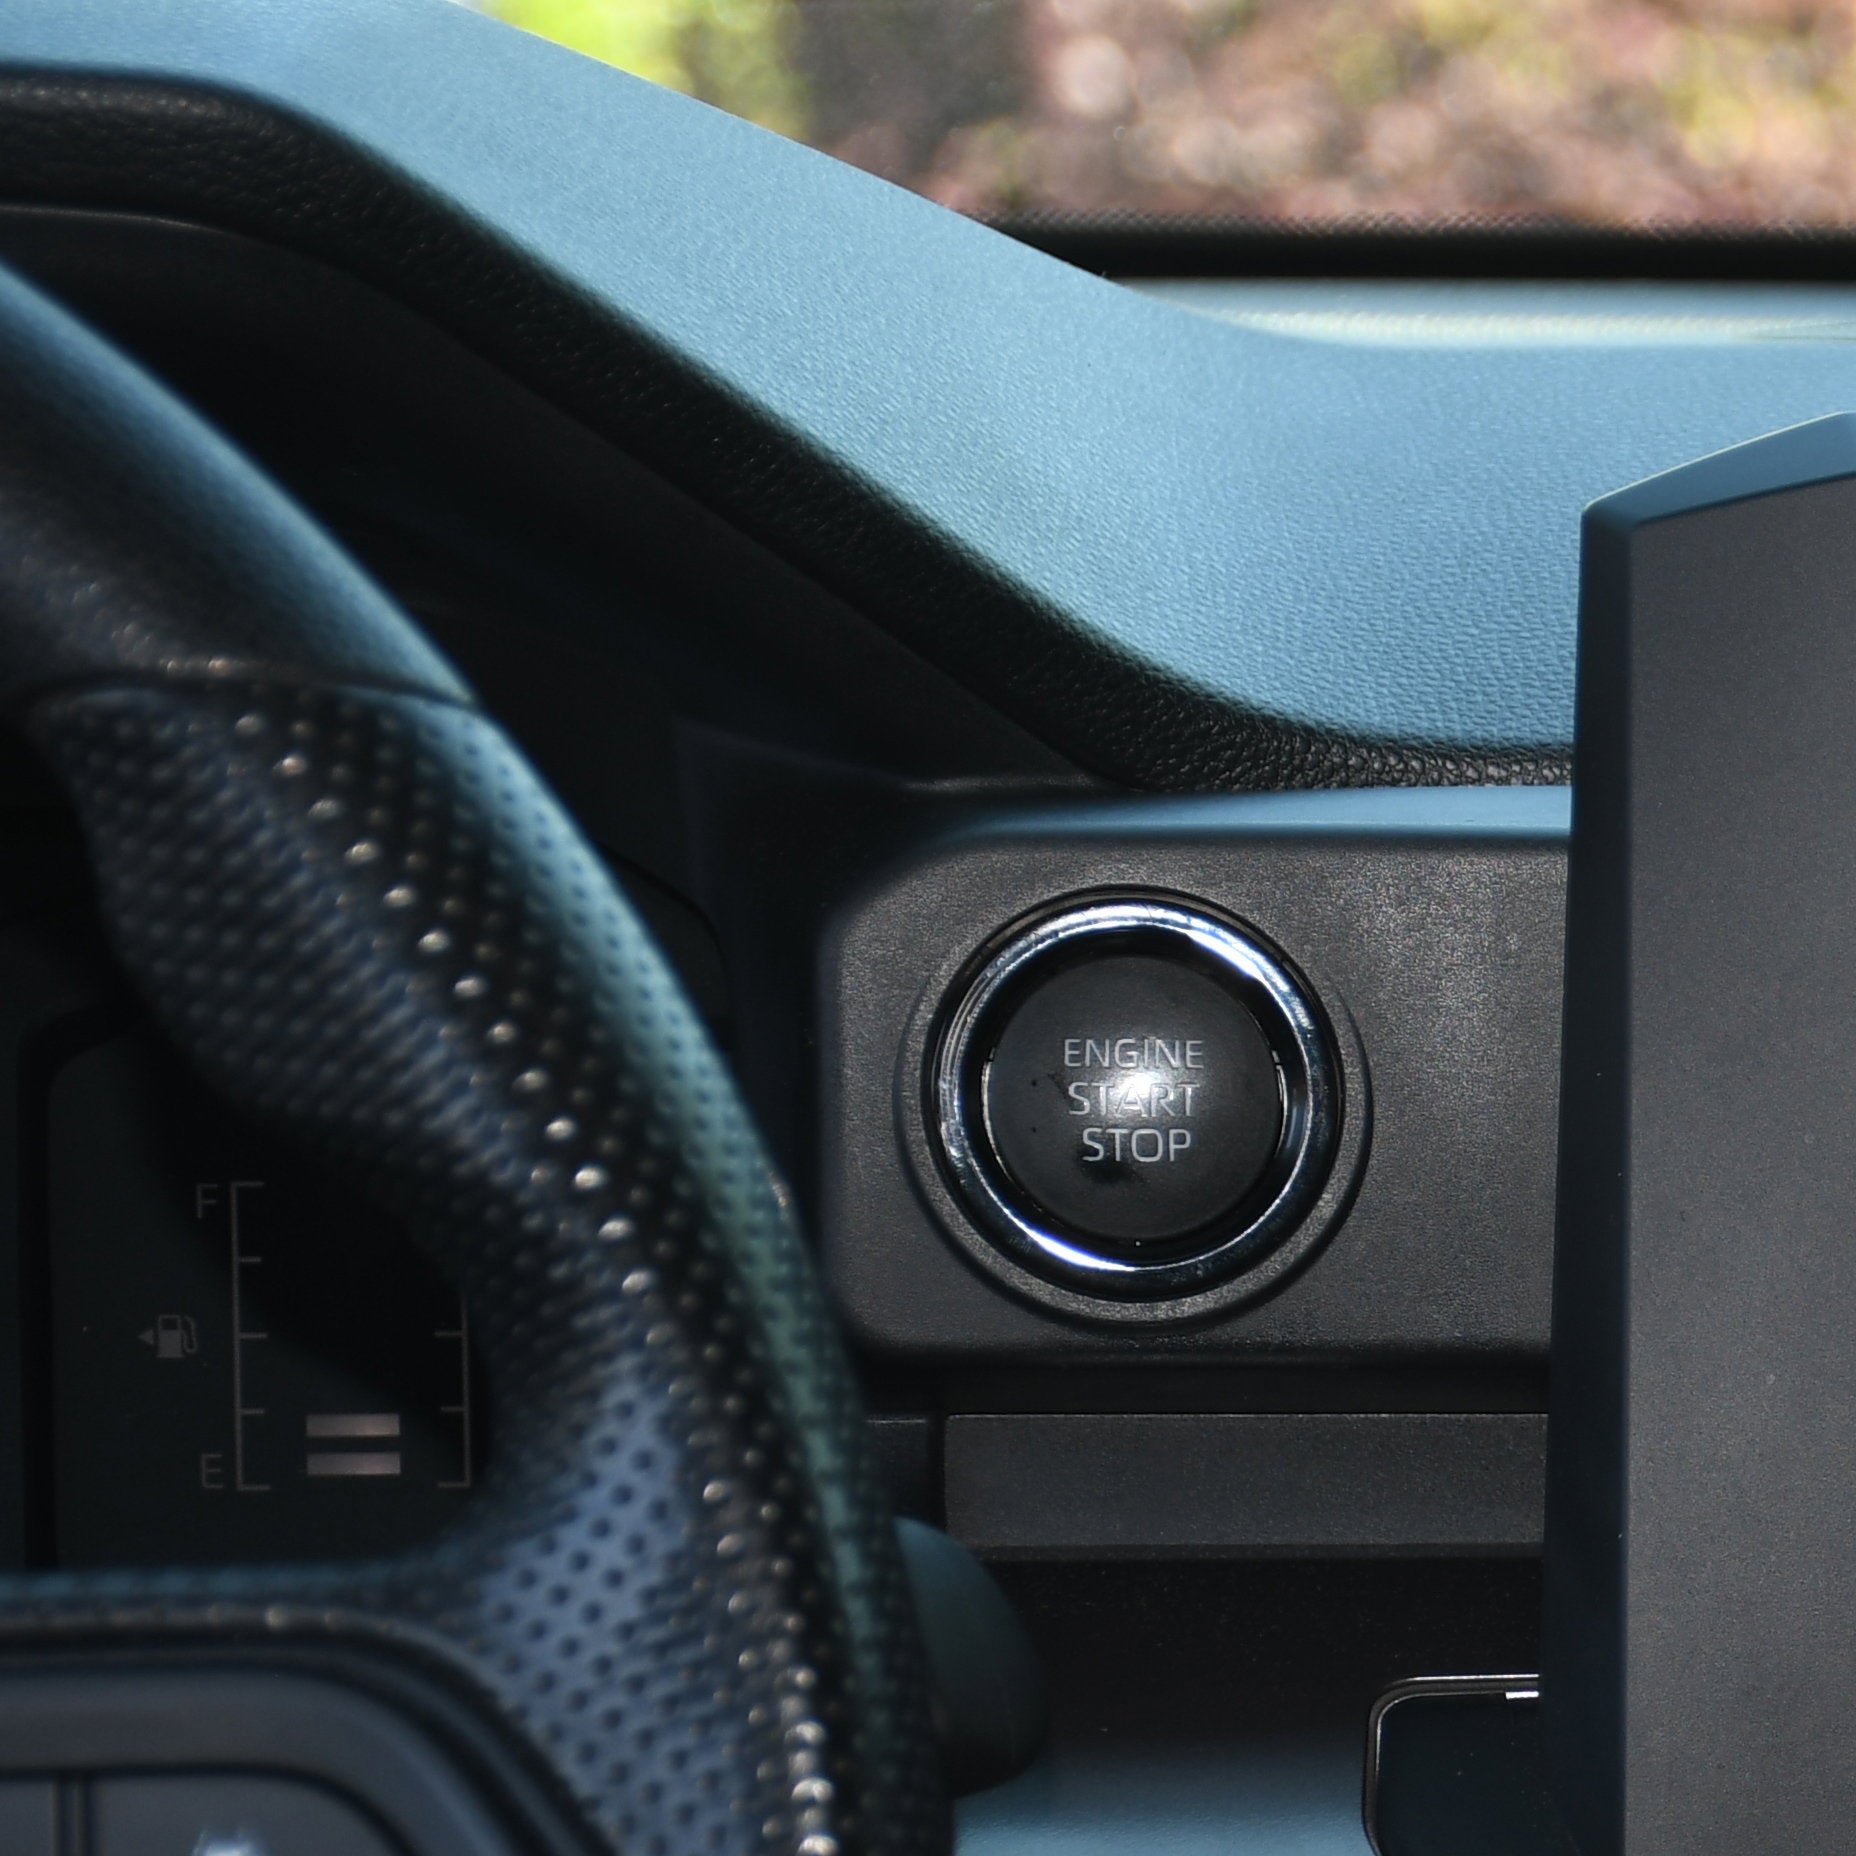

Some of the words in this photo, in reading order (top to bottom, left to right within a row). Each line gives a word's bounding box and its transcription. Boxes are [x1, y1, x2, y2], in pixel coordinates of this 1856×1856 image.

[1063, 1037, 1205, 1069] ENGINE
[1067, 1081, 1201, 1118] START
[1082, 1127, 1192, 1163] STOP
[195, 1183, 219, 1219] F
[201, 1452, 224, 1490] E
